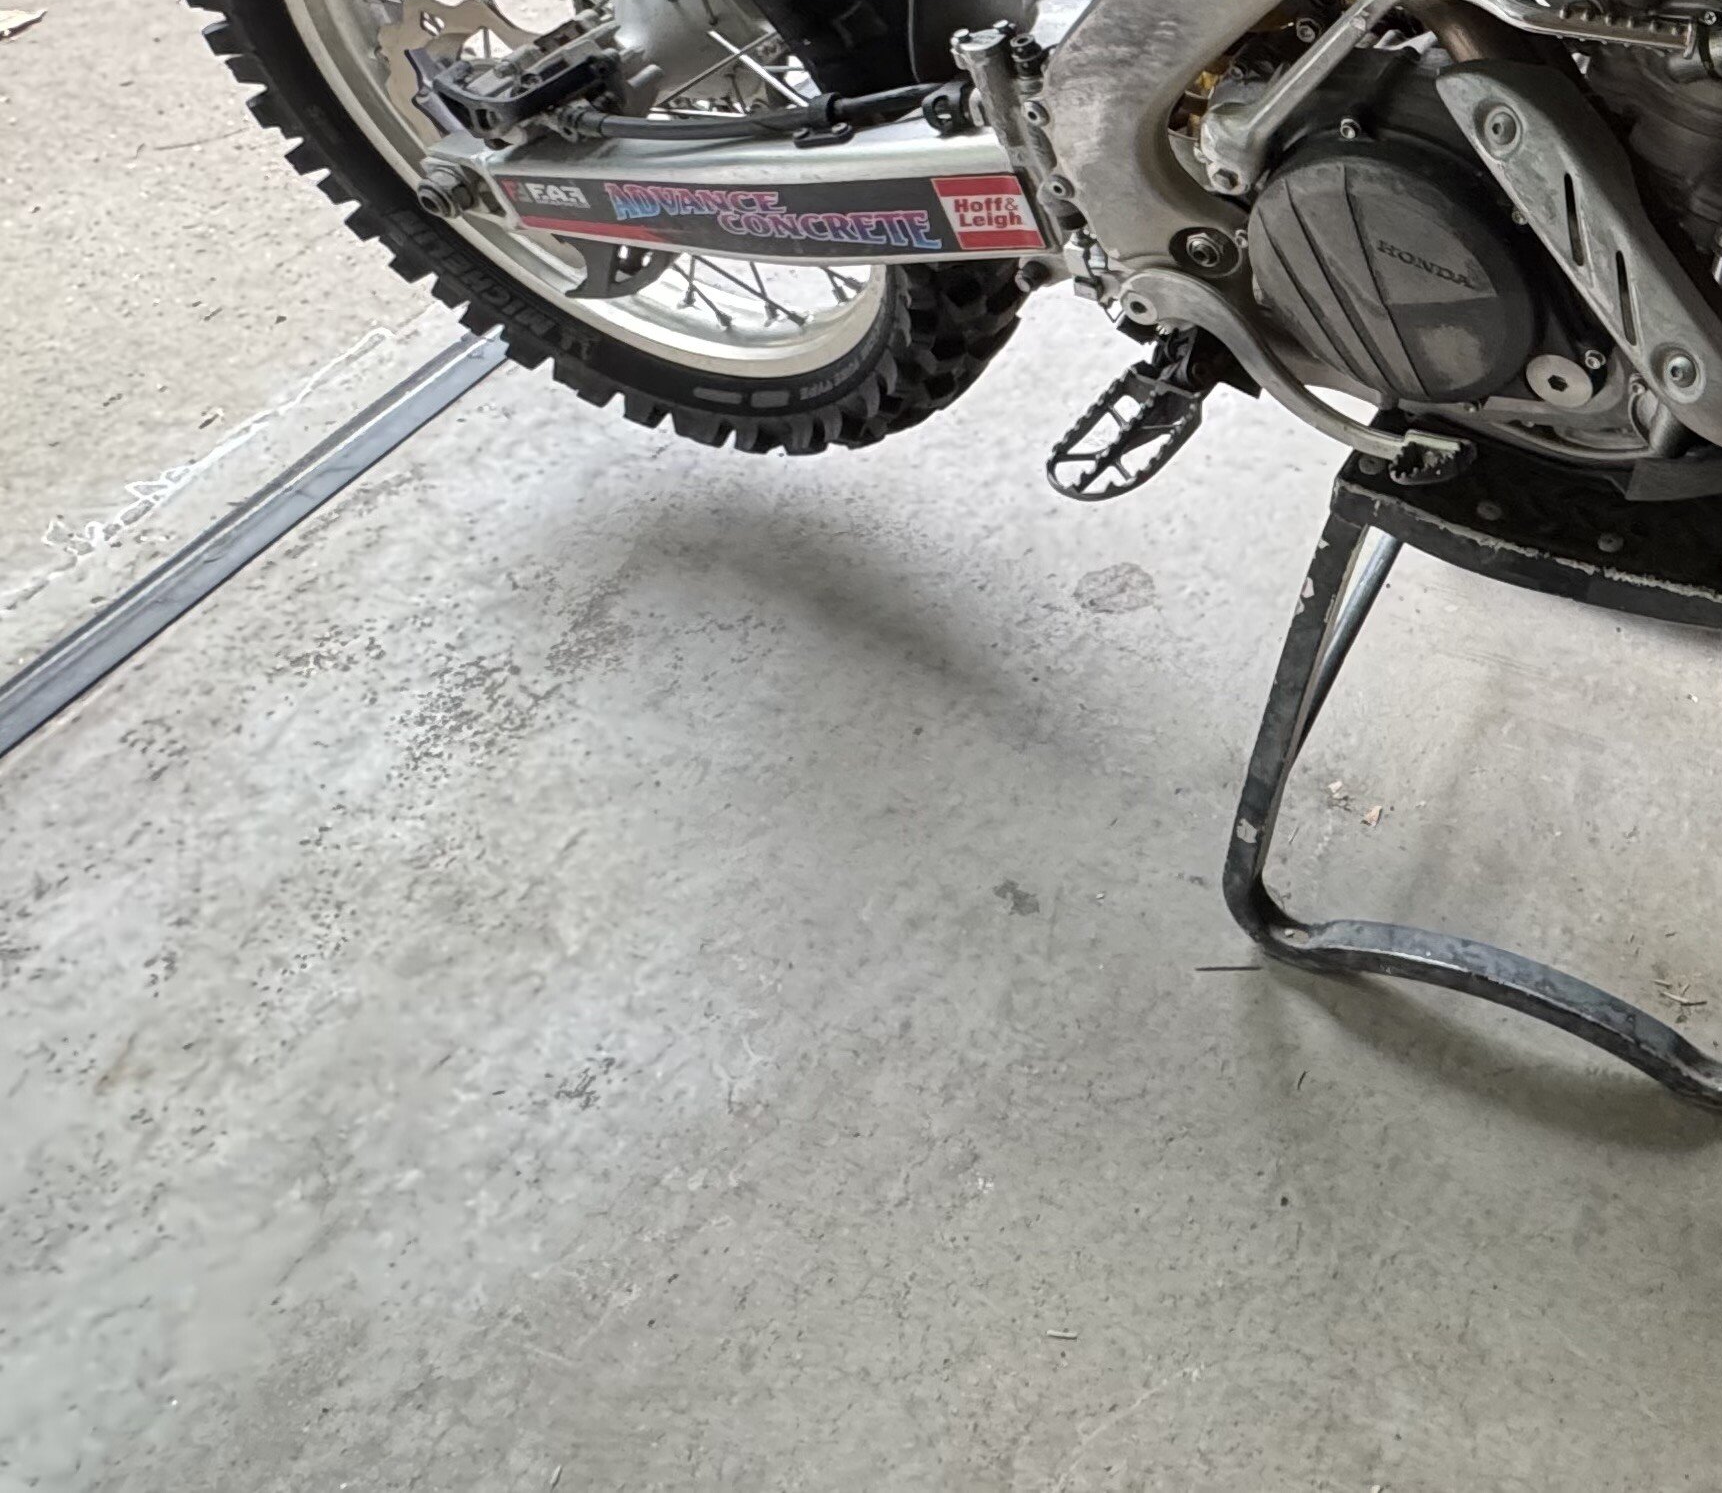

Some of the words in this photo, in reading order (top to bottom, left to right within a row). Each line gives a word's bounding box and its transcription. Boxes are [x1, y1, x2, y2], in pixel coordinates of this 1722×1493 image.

[604, 181, 788, 222] ADVANCE
[953, 196, 1020, 214] Hoff&
[959, 210, 1023, 229] Leigh
[716, 209, 943, 250] CONCRETE
[1377, 238, 1477, 292] HONDA
